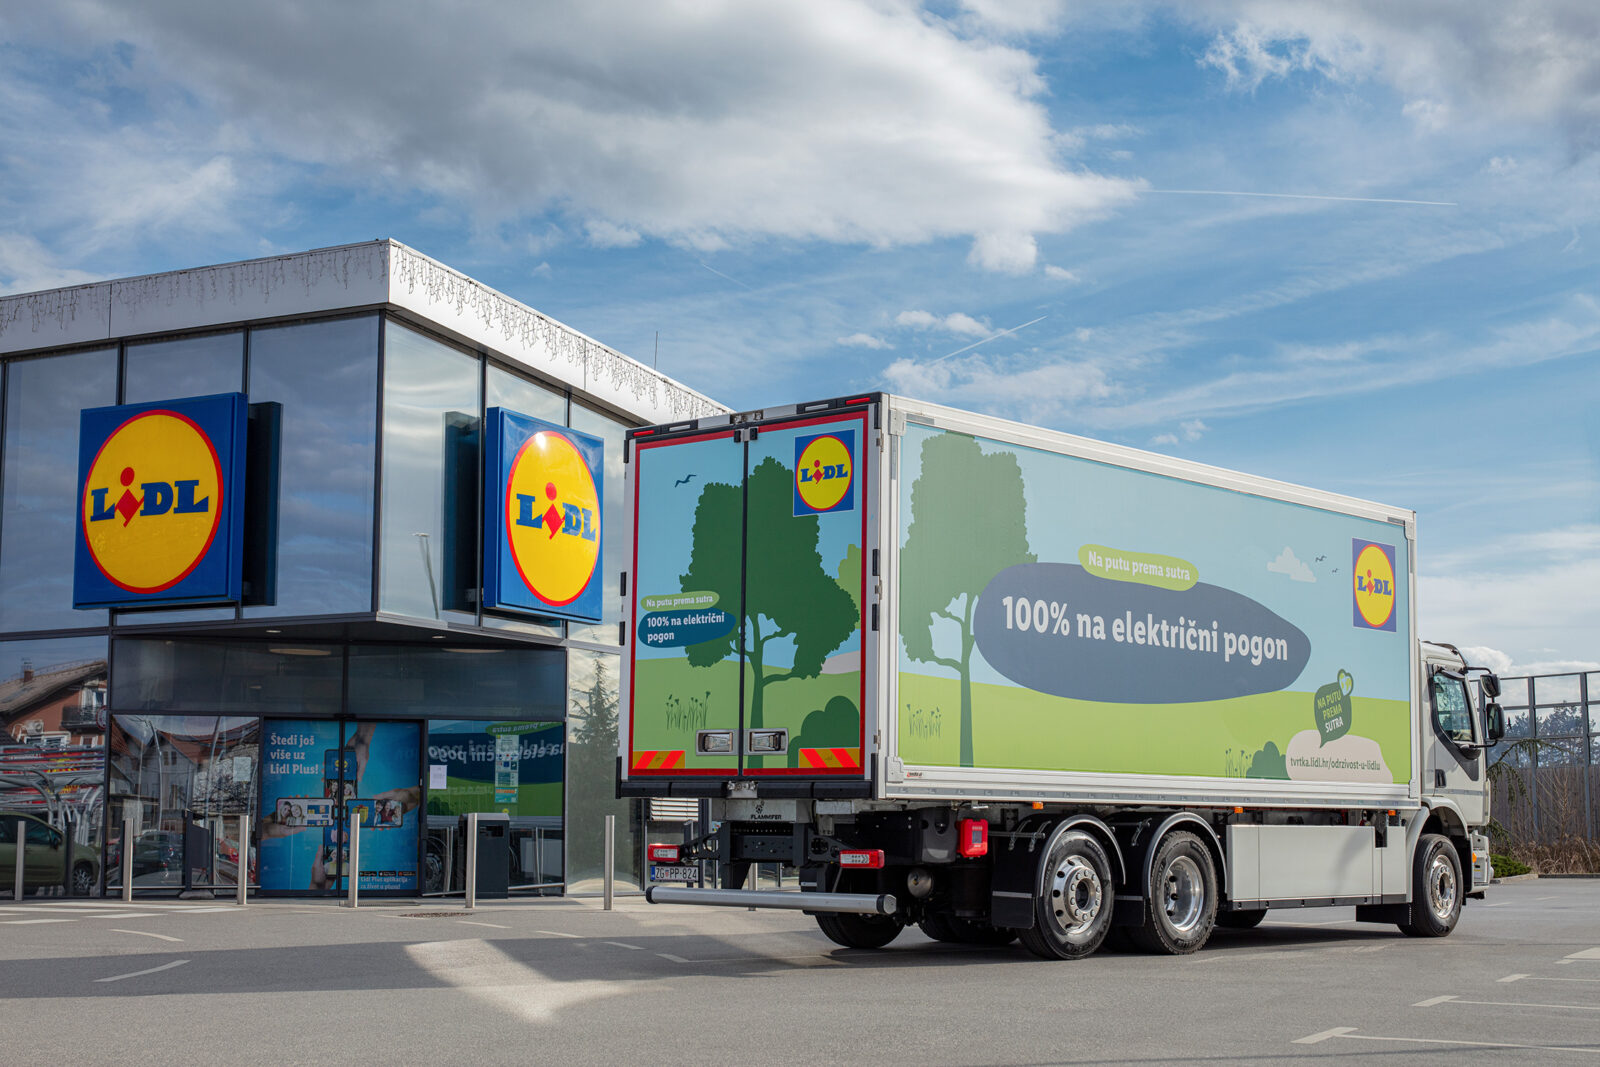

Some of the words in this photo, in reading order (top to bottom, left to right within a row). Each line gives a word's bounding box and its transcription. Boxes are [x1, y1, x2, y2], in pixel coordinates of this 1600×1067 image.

[1088, 550, 1103, 568] Na
[1105, 553, 1130, 574] putu
[1132, 560, 1164, 578] prema
[1165, 563, 1190, 581] sutra
[646, 599, 655, 607] Na
[656, 598, 672, 608] putu
[673, 597, 695, 607] prema
[696, 595, 713, 603] sutra
[647, 616, 669, 628] 100%
[671, 618, 682, 626] na
[683, 611, 725, 625] električni
[647, 632, 675, 644] pogon
[1002, 596, 1070, 636] 100%
[1077, 612, 1106, 640] na
[1112, 610, 1218, 653] električni
[1224, 631, 1288, 666] pogon
[1317, 697, 1327, 710] NA
[1326, 689, 1341, 706] PUTU
[1322, 703, 1343, 720] PREMA
[1324, 716, 1344, 733] SUTRA
[270, 732, 297, 746] Štedi
[299, 734, 315, 748] još
[270, 748, 291, 760] više
[293, 751, 305, 760] uz
[270, 763, 290, 774] Lidl
[292, 763, 319, 775] Plus!
[1290, 756, 1380, 771] tvrtka.lidl.hr/odrzivost-u-lidlu
[655, 869, 665, 878] ZG
[669, 868, 697, 879] PP-824
